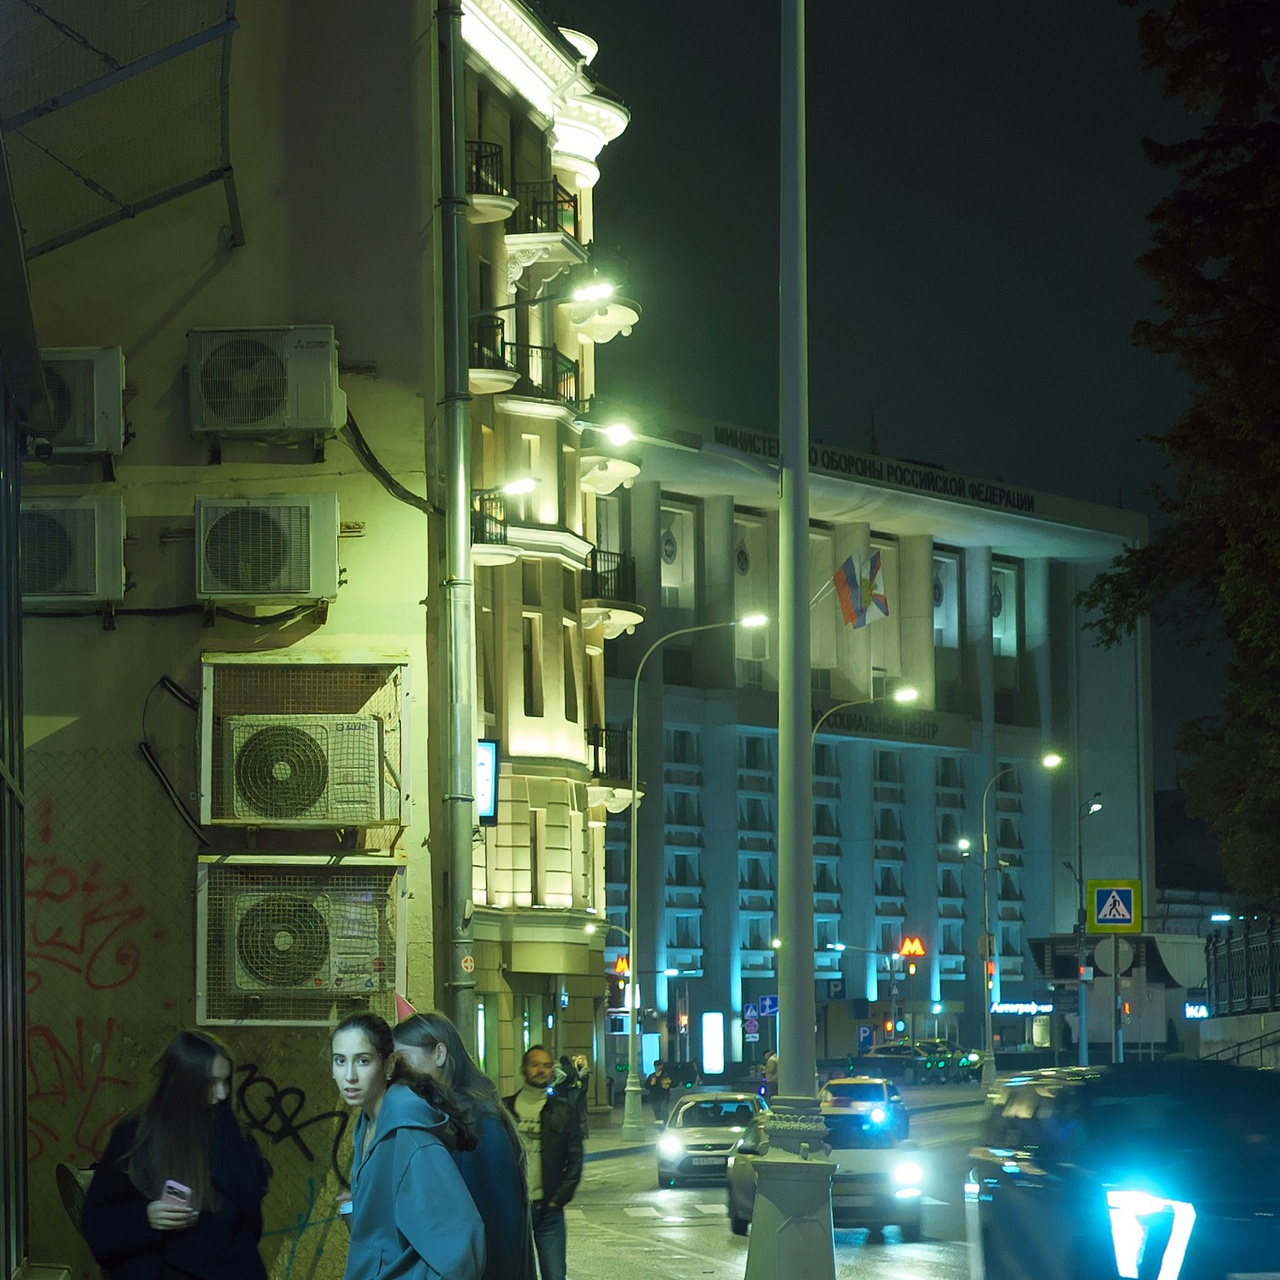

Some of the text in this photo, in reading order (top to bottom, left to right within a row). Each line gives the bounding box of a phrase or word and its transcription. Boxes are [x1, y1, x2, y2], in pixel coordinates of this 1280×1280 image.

[821, 449, 884, 482] ОБОРОНЫ
[886, 464, 967, 499] РОССИЙСКОЙ
[967, 481, 1035, 513] ФЕДЕРАЦИИ
